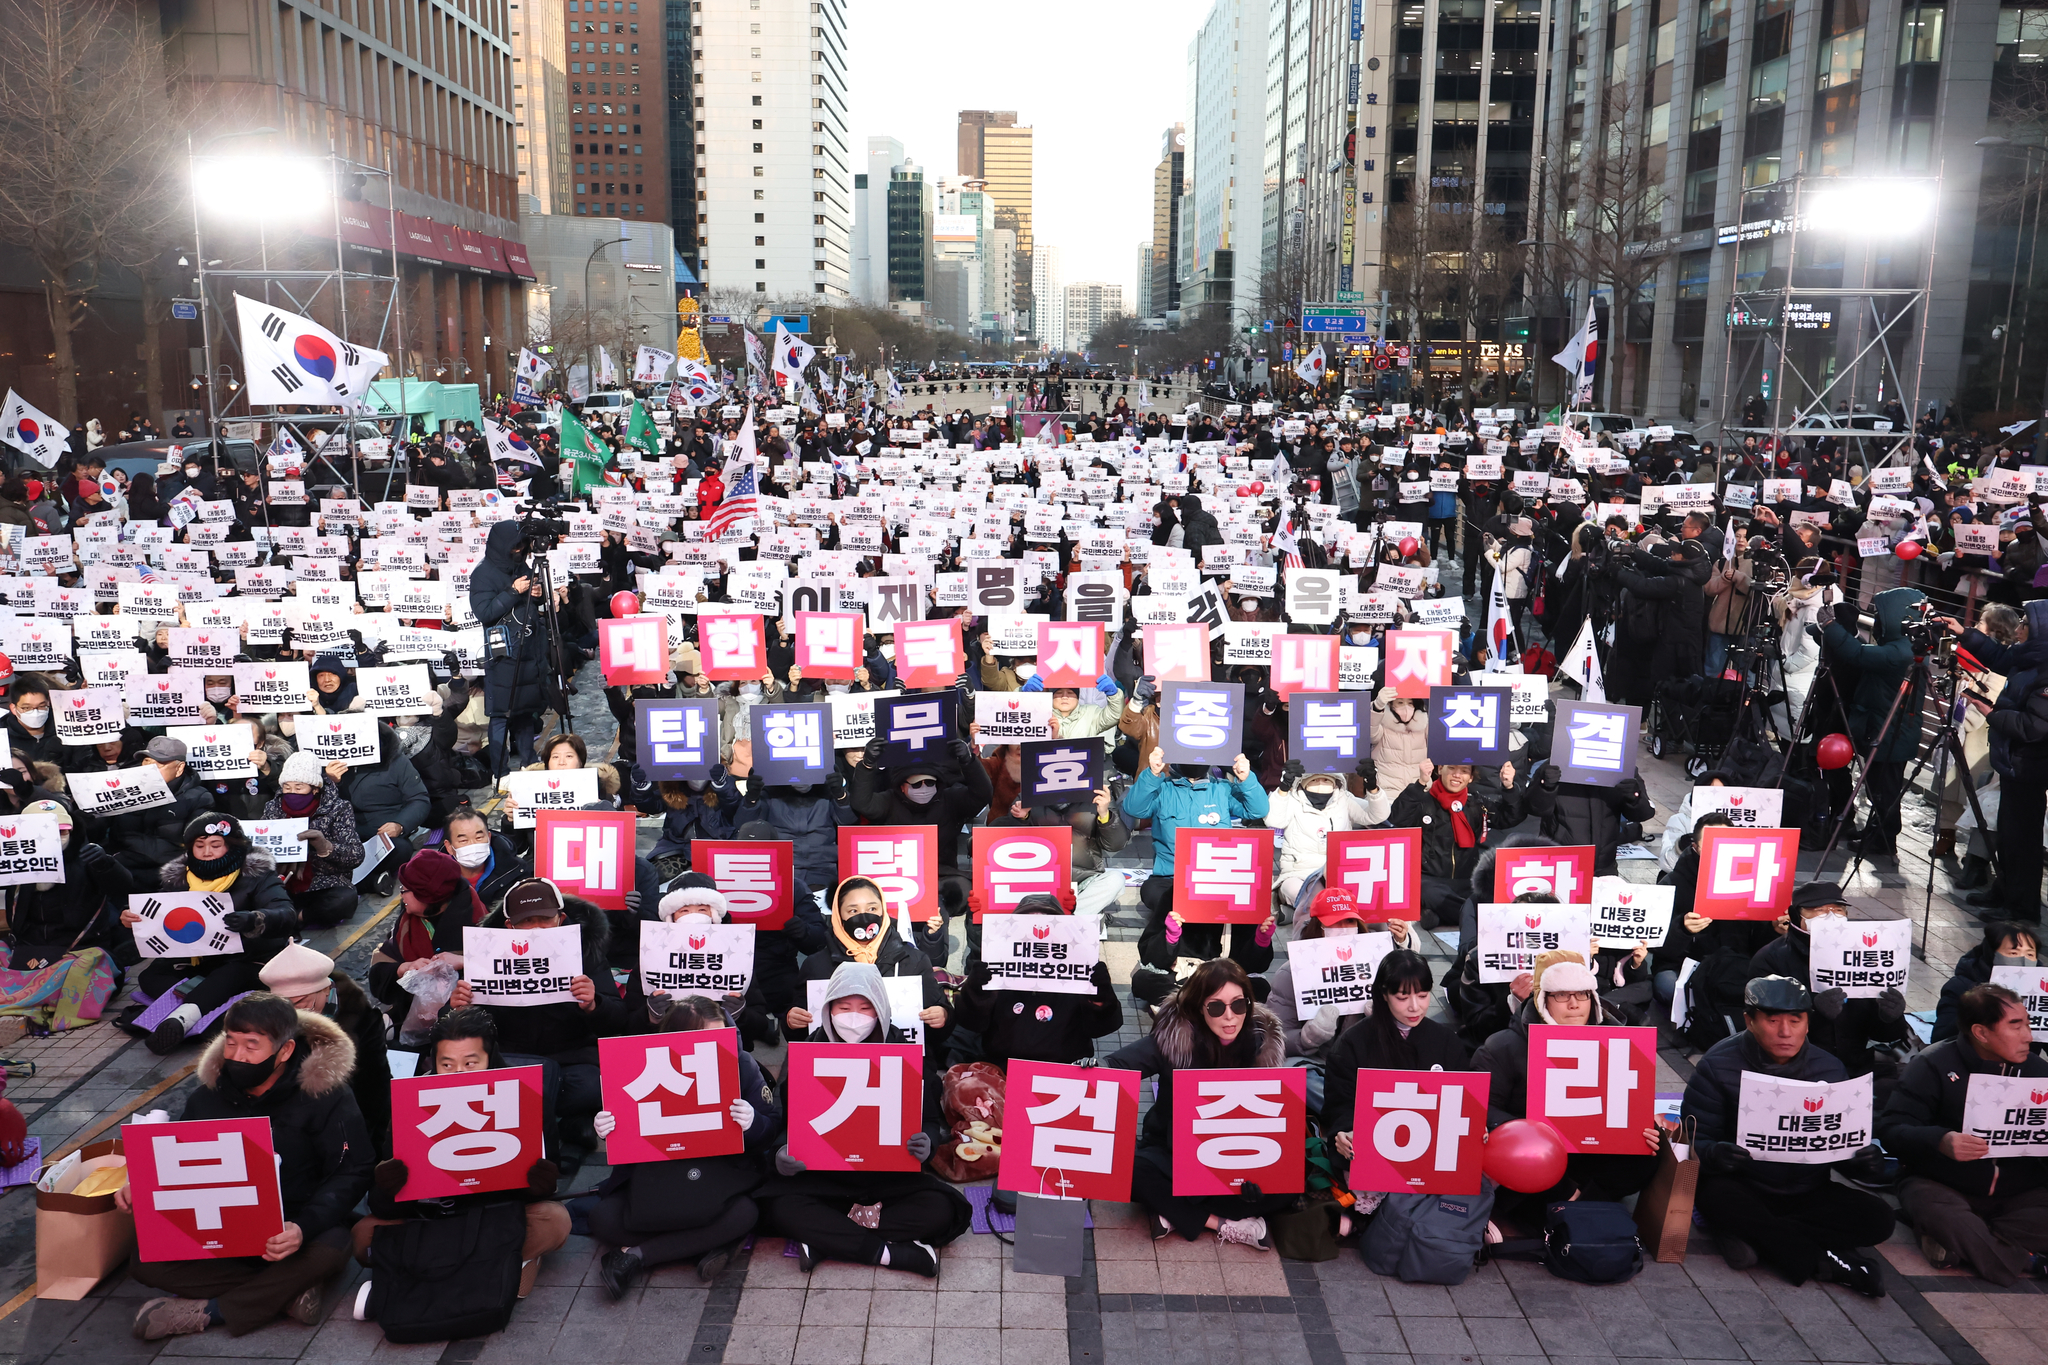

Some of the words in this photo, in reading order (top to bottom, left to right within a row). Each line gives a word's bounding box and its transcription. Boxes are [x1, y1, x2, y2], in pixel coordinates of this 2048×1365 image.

[1324, 318, 1345, 326] 무교로
[1880, 475, 1902, 485] 대통령
[2002, 480, 2026, 492] 대통령
[1677, 488, 1700, 501] 대통령
[1991, 487, 2033, 501] 국민변호인단
[1666, 497, 1712, 511] 국민변호인단
[768, 543, 790, 553] 대통령
[1092, 540, 1113, 548] 대통령
[1957, 542, 1996, 552] 국민변호인단
[1965, 535, 1985, 545] 대통령
[248, 577, 272, 586] 대통령
[976, 567, 1014, 606] 명
[1387, 576, 1411, 587] 대통령
[135, 597, 162, 606] 대통령
[312, 596, 339, 604] 대통령
[405, 595, 430, 603] 대통령
[646, 597, 695, 608] 국민변호인단
[655, 589, 683, 600] 대통령
[740, 588, 765, 601] 대통령
[791, 586, 830, 611] 이
[877, 583, 918, 621] 재
[1074, 583, 1116, 622] 을
[1293, 576, 1332, 615] 옥
[51, 602, 78, 611] 대통령
[123, 604, 175, 616] 국민변호인단
[1360, 602, 1386, 613] 대통령
[1427, 608, 1455, 616] 대통령
[203, 616, 231, 625] 대통령
[303, 622, 335, 632] 대통령
[91, 630, 120, 639] 대통령
[293, 629, 349, 643] 국민변호인단
[806, 617, 856, 666] 민
[1241, 639, 1269, 647] 대통령
[22, 642, 52, 652] 대통령
[79, 639, 135, 649] 국민변호인단
[187, 646, 220, 656] 대통령
[387, 643, 447, 654] 국민변호인단
[609, 622, 662, 672] 대
[707, 619, 758, 669] 한
[903, 625, 952, 675] 국
[1046, 626, 1097, 676] 지
[8, 654, 67, 666] 국민변호인단
[1153, 629, 1203, 677] 켜
[1392, 636, 1445, 682] 자
[1280, 640, 1330, 689] 내
[255, 681, 288, 692] 대통령
[376, 685, 409, 696] 대통령
[146, 693, 182, 704] 대통령
[240, 694, 306, 705] 국민변호인단
[64, 709, 101, 722] 대통령
[130, 706, 200, 718] 국민변호인단
[996, 712, 1031, 723] 대통령
[1174, 690, 1230, 747] 종
[891, 702, 944, 749] 무
[1303, 703, 1356, 755] 북
[1445, 695, 1497, 747] 척
[650, 709, 705, 762] 탄
[833, 725, 875, 740] 국민변호
[980, 724, 1047, 737] 국민변호인단
[318, 734, 356, 746] 대통령
[766, 713, 820, 766] 핵
[1569, 710, 1626, 770] 결
[192, 745, 231, 757] 대통령
[1036, 750, 1090, 792] 효
[96, 784, 141, 804] 대통령
[535, 792, 574, 804] 대통령
[0, 838, 36, 855] 통령
[0, 858, 59, 874] 변호인단
[552, 827, 617, 890] 대
[857, 839, 919, 906] 령
[990, 842, 1054, 903] 은
[1192, 843, 1255, 904] 복
[1344, 842, 1404, 903] 귀
[1713, 843, 1780, 902] 다
[714, 853, 776, 912] 통
[1601, 907, 1646, 922] 대통령
[1507, 932, 1558, 949] 대통령
[1014, 942, 1067, 959] 대통령
[1843, 951, 1893, 967] 대통령
[494, 958, 549, 975] 대통령
[670, 953, 723, 970] 대통령
[1484, 951, 1534, 971] 국민변
[645, 972, 746, 991] 국민변호인단
[1322, 963, 1372, 985] 대통령
[1816, 969, 1906, 990] 국민변호인단
[471, 977, 575, 998] 국민변호인단
[1302, 980, 1373, 1009] 국민변호
[622, 1041, 723, 1136] 선
[1545, 1039, 1637, 1128] 라
[809, 1056, 902, 1146] 거
[416, 1079, 521, 1170] 정
[1026, 1075, 1119, 1173] 검
[1193, 1080, 1286, 1169] 증
[1778, 1111, 1842, 1134] 대통령
[2003, 1109, 2048, 1125] 대통
[1373, 1083, 1469, 1171] 하
[1746, 1130, 1866, 1153] 국민변호인단
[1972, 1128, 2048, 1146] 국민변호
[153, 1133, 257, 1229] 부
